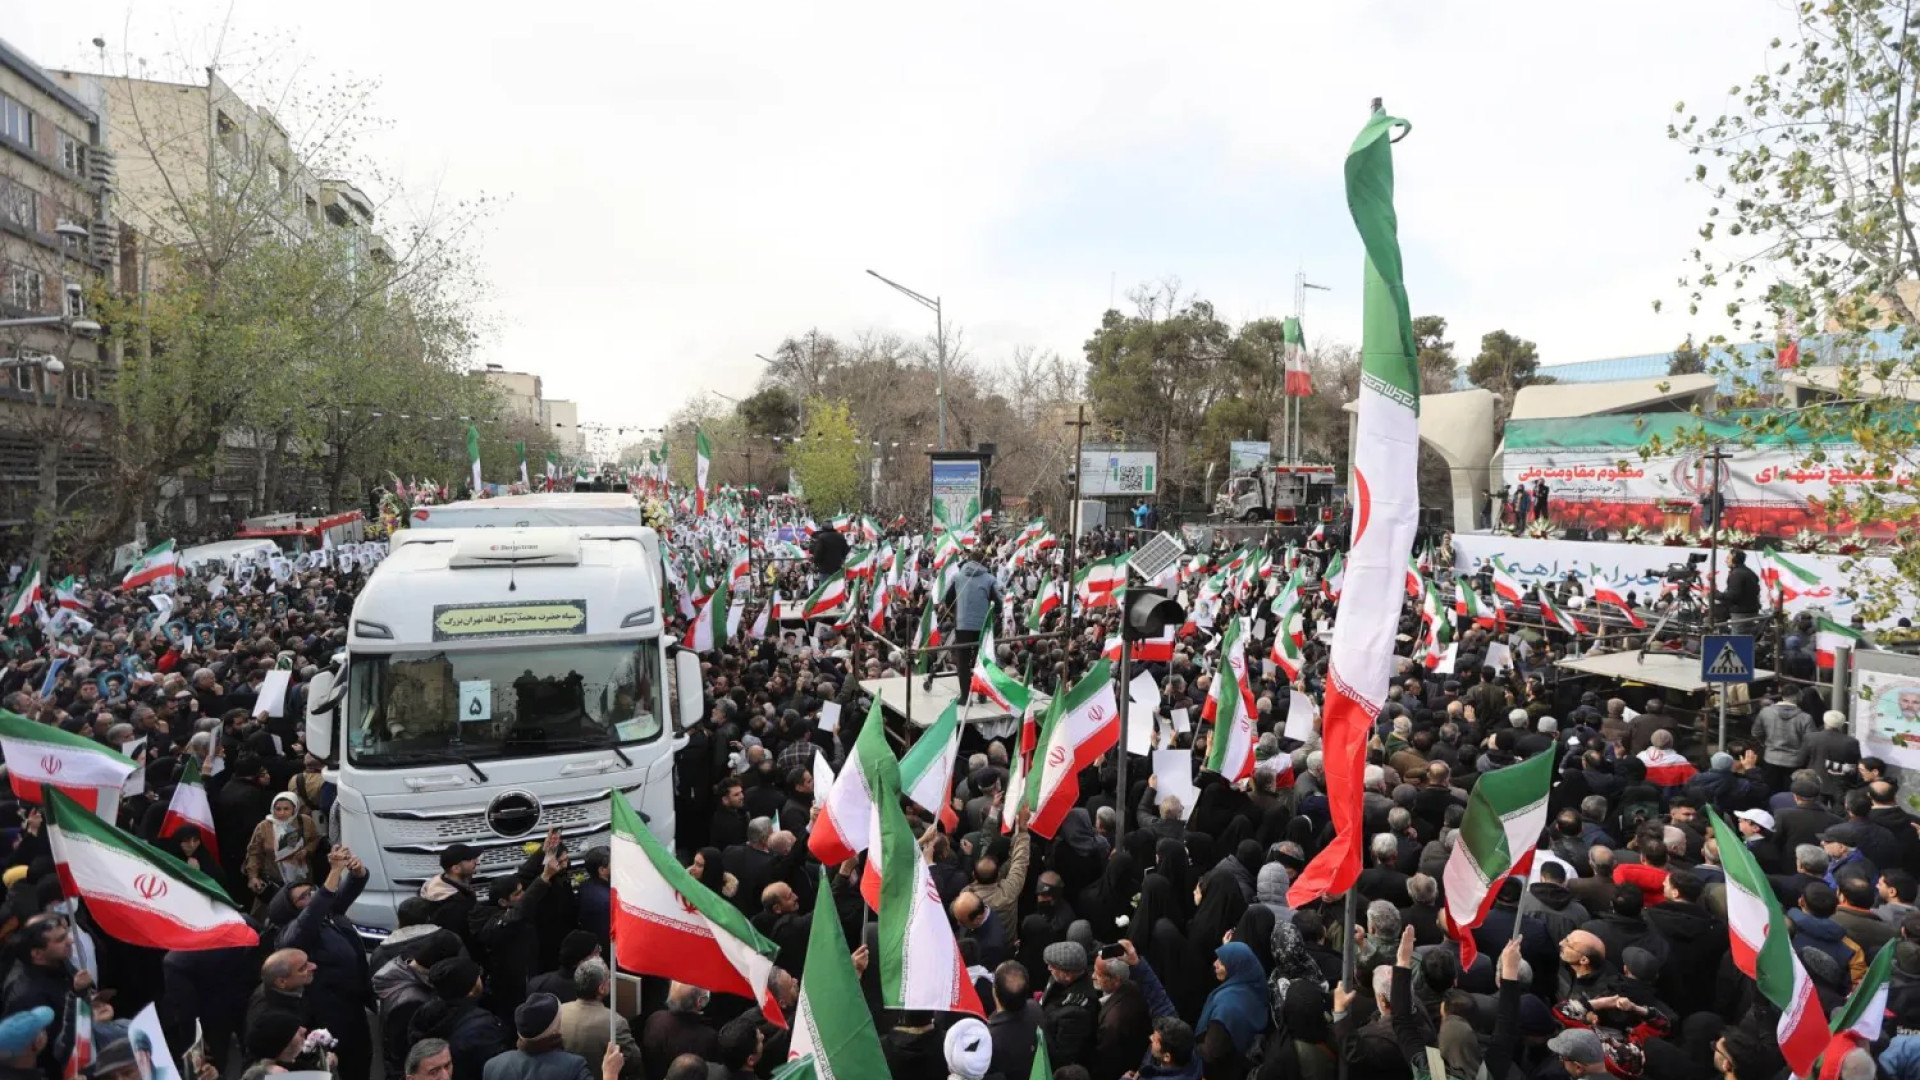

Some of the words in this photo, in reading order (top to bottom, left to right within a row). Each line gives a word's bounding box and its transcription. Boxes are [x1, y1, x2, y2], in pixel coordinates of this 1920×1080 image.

[1518, 465, 1542, 482] ملی
[1544, 464, 1596, 482] مقاومت
[465, 616, 483, 625] تهران
[484, 615, 496, 623] الله
[497, 615, 516, 623] رسول
